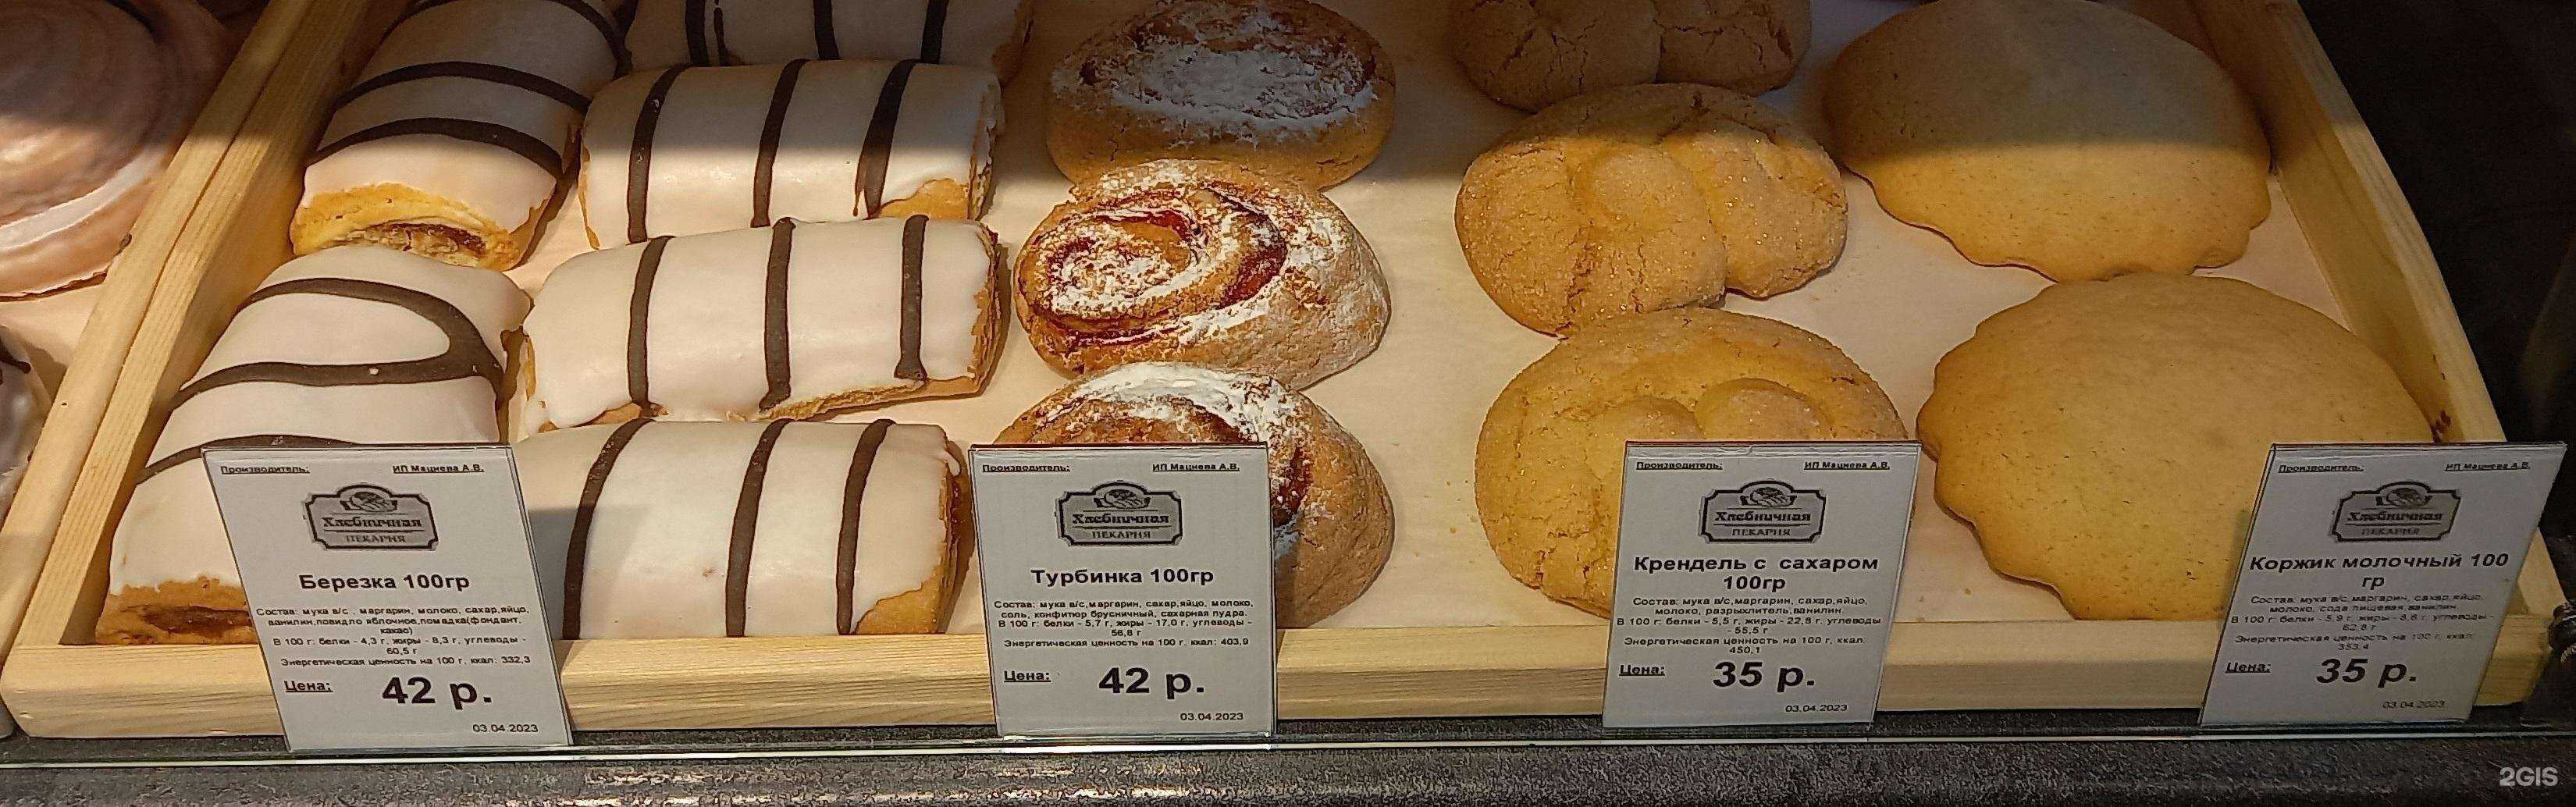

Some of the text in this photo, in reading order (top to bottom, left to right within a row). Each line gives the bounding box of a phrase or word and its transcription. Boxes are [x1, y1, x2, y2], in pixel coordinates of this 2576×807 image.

[393, 465, 408, 474] ИП
[982, 464, 1070, 473] Производитель:
[1219, 463, 1240, 471] А.В.
[1714, 511, 1811, 523] Хлебничная
[1635, 557, 1878, 574] Крендель с сахаром
[2250, 553, 2509, 573] Коржик молочный 100
[299, 574, 470, 592] Березка 100гр
[1031, 568, 1215, 587] Турбинка 100гр
[2362, 577, 2386, 590] гр
[1723, 577, 1786, 592] 100гр
[1034, 610, 1087, 619] конфитюр
[1091, 610, 1157, 619] брусничный,
[1193, 619, 1244, 627] углеводы
[1624, 638, 1720, 646] Энергетическая
[2235, 635, 2329, 644] Энергетическая
[1729, 646, 1760, 655] 450,1
[281, 659, 365, 667] Энергетическая
[1618, 661, 1815, 693] Цена: 35 р.
[2225, 659, 2418, 688] Цена: 35 р.
[1004, 667, 1204, 699] Цена: 42 р.
[284, 677, 493, 709] Цена: 42 р.
[472, 724, 539, 733] 03.04.2023
